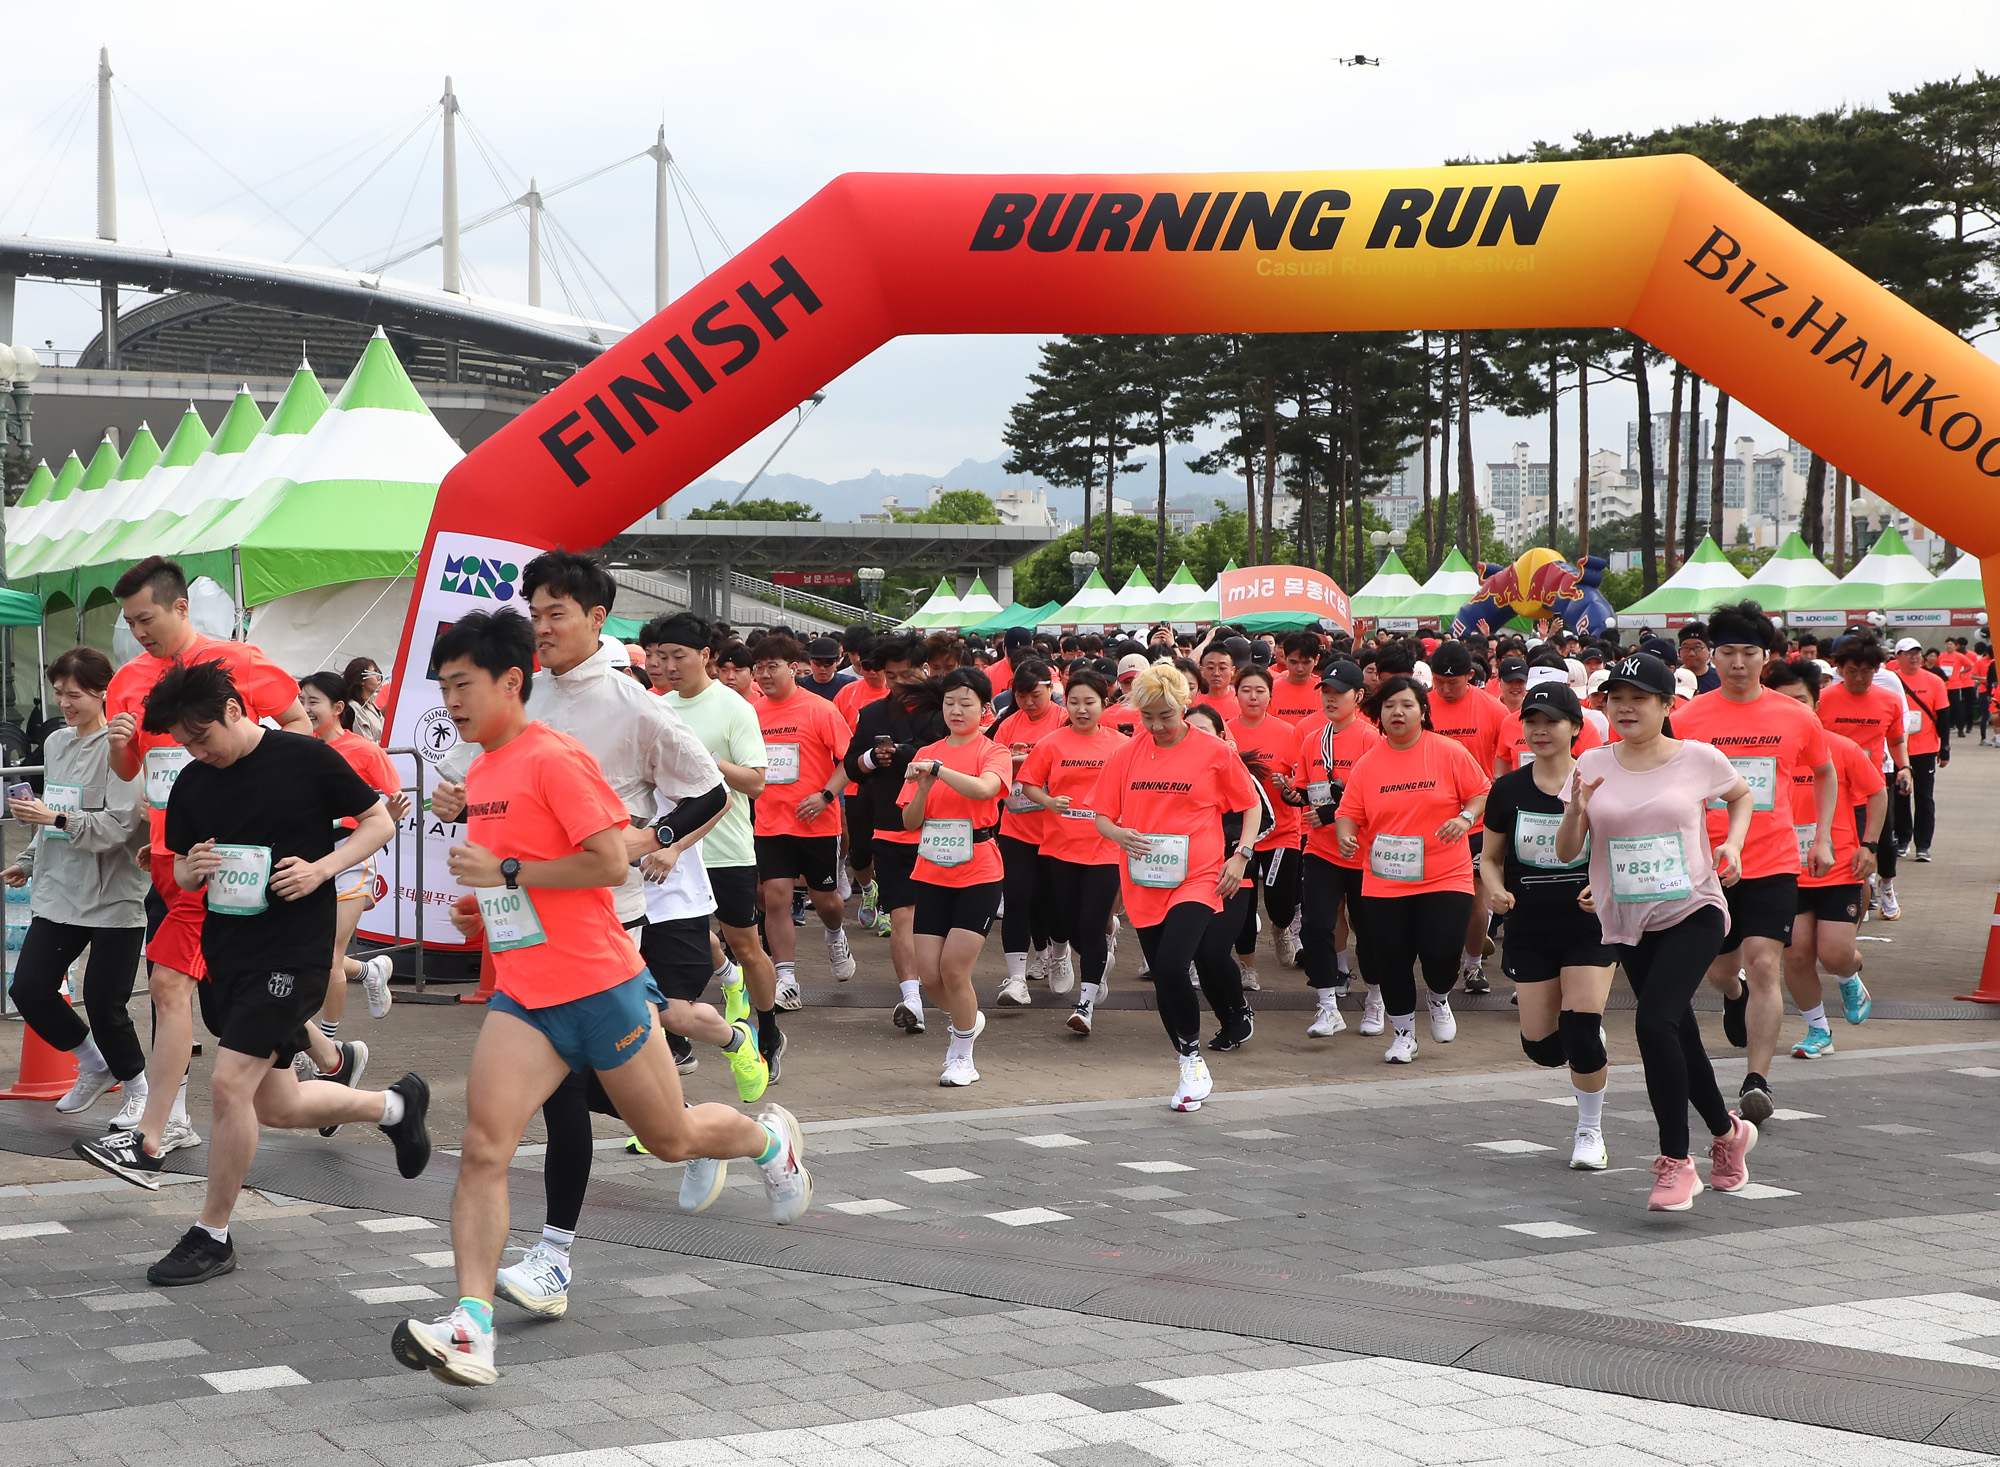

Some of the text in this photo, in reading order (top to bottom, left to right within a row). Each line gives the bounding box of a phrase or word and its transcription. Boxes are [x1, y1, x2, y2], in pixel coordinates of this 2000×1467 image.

[969, 184, 1560, 253] BURNING RUN
[1256, 253, 1535, 278] Casual Running Festival
[538, 255, 823, 488] FINISH
[1711, 736, 1782, 746] BURNING RUN
[768, 758, 793, 766] 7283
[152, 772, 159, 780] M
[1748, 776, 1767, 788] 32
[1131, 781, 1192, 792] BURNING RUN
[1380, 781, 1436, 793] BURNING RUN
[490, 801, 509, 814] RUN
[1523, 817, 1547, 825] BURNING
[932, 836, 966, 847] 8262
[1523, 835, 1533, 843] W
[1144, 853, 1179, 866] 8408
[1383, 851, 1417, 863] 8412
[1384, 867, 1402, 875] C-513
[1616, 857, 1675, 875] W 8312
[218, 869, 259, 886] 7008
[1659, 879, 1683, 890] C-467
[484, 894, 521, 917] 7100
[615, 1025, 646, 1052] HOKA
